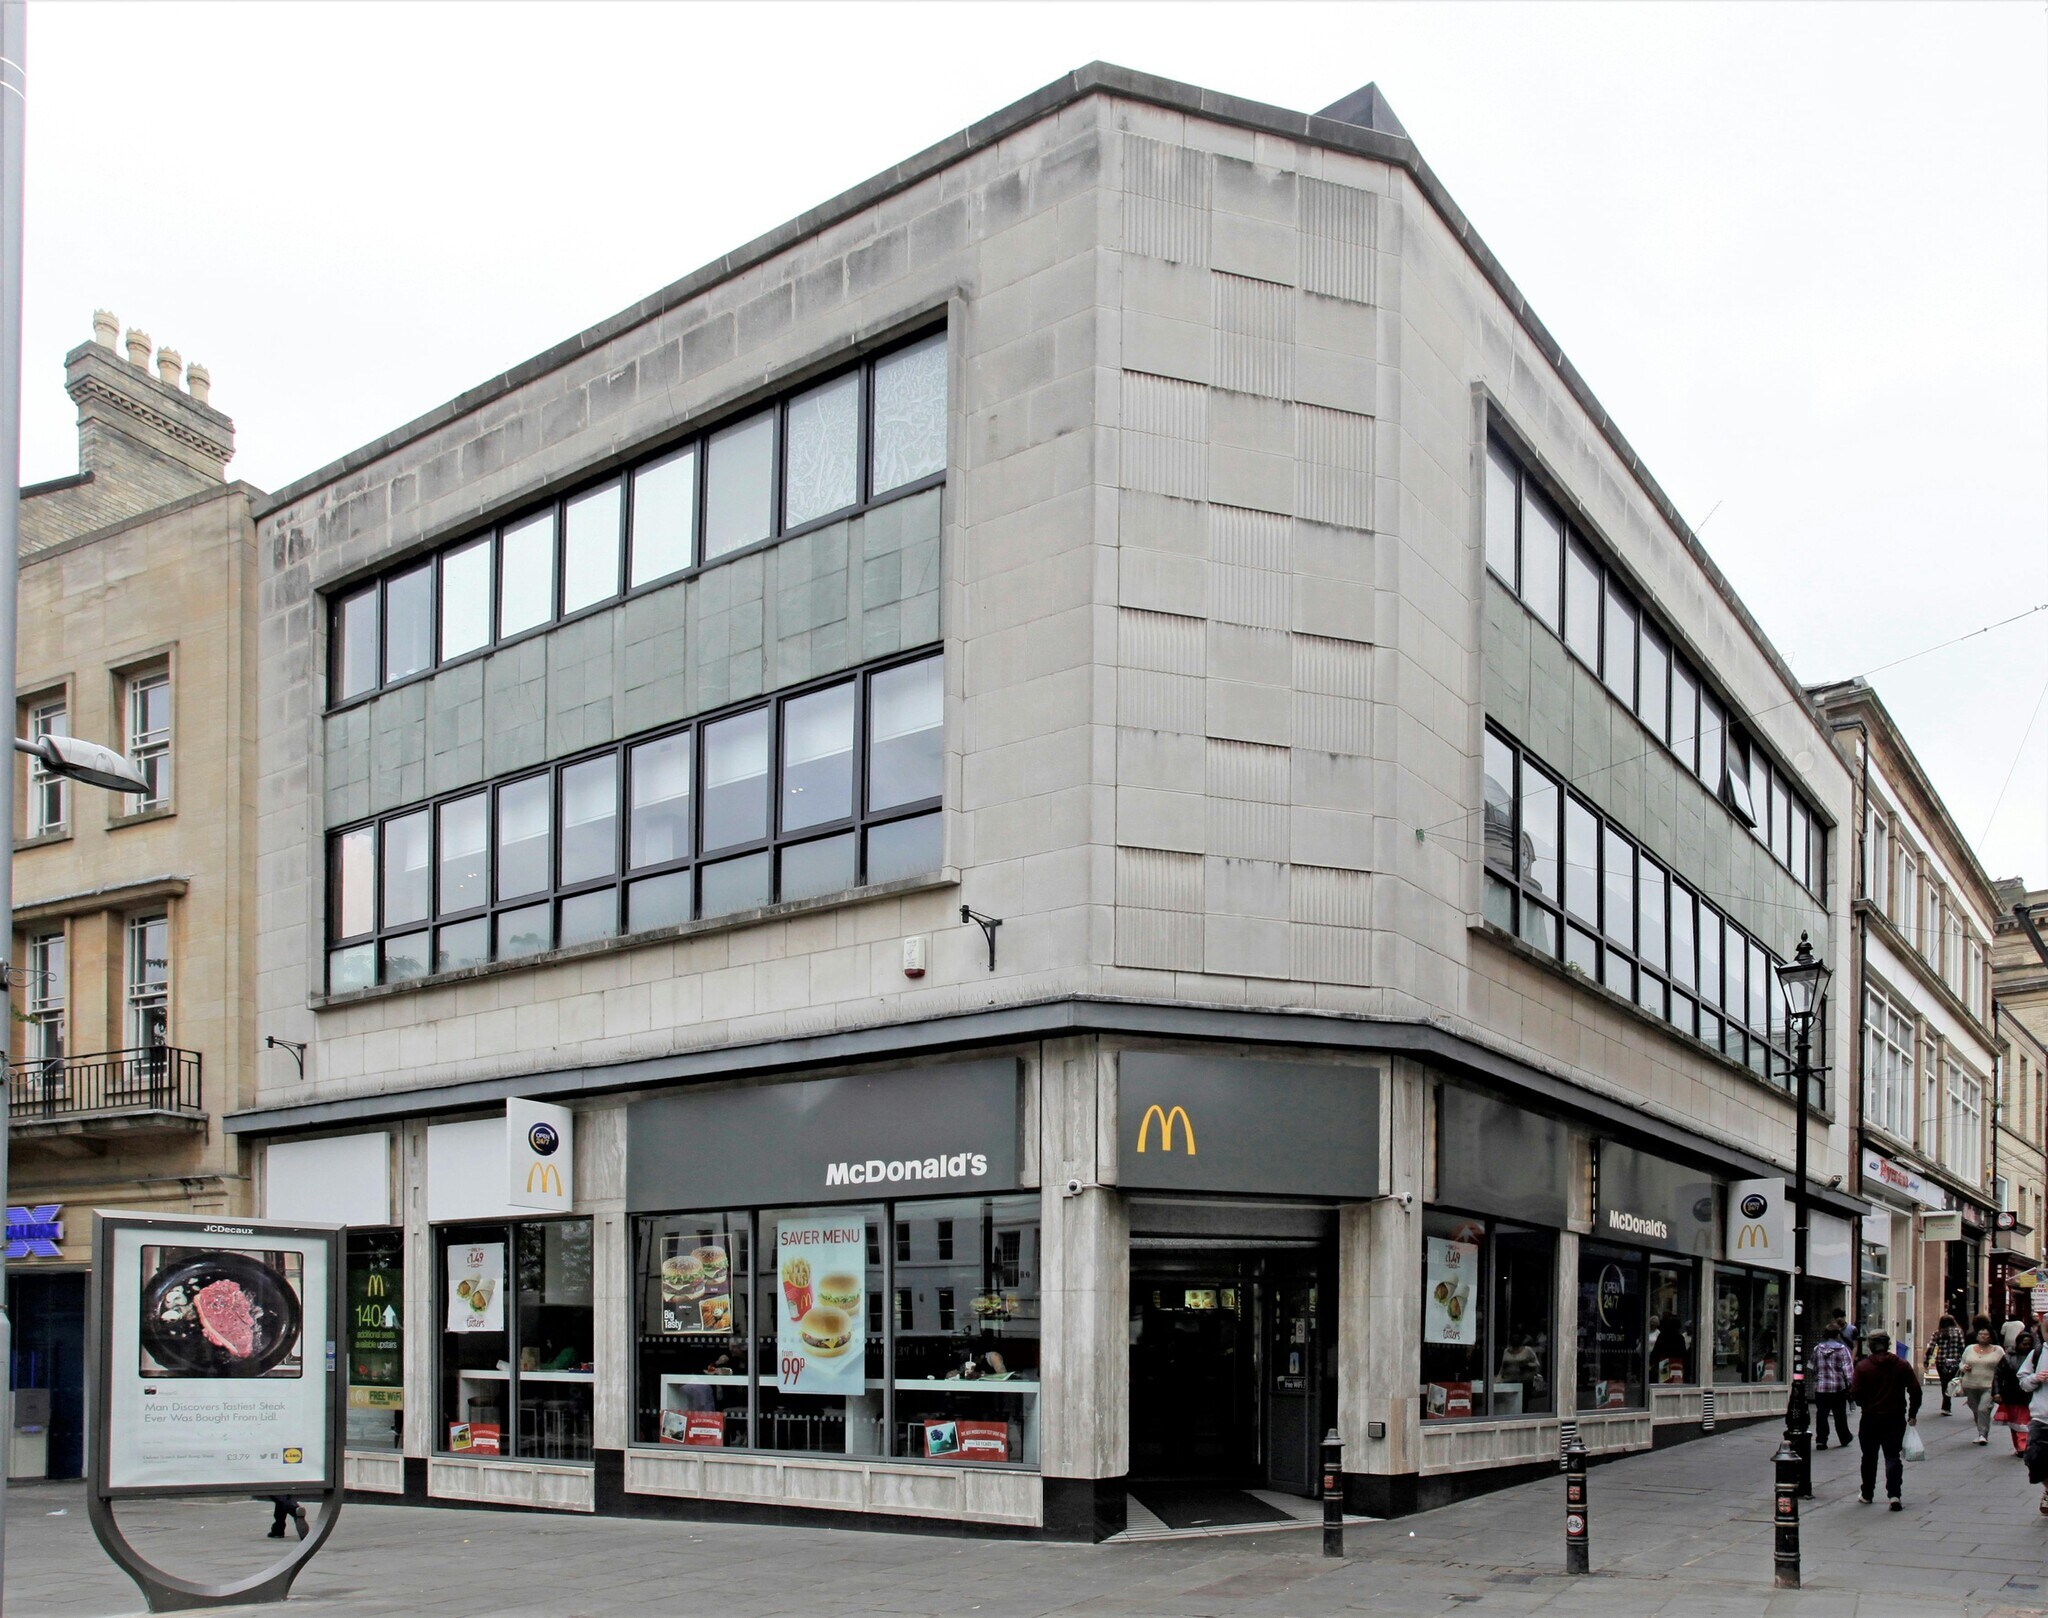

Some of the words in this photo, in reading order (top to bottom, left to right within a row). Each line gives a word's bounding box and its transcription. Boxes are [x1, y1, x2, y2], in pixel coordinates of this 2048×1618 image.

[825, 1152, 988, 1186] McDonald's
[203, 1224, 254, 1235] JCDecaux
[1609, 1209, 1668, 1239] McDonald's
[781, 1230, 820, 1246] SAVER
[823, 1229, 860, 1244] MENU
[1604, 1281, 1619, 1293] OPEN
[1604, 1294, 1619, 1309] 24/7
[356, 1304, 381, 1327] 140
[664, 1310, 675, 1321] Big
[664, 1320, 683, 1330] Tasty
[781, 1357, 805, 1385] 99p
[369, 1390, 386, 1401] FREE
[144, 1403, 168, 1412] Man
[172, 1402, 220, 1411] Discovers
[222, 1402, 256, 1411] Tastiest
[259, 1401, 286, 1410] Steak
[144, 1414, 167, 1423] Ever
[170, 1413, 193, 1422] Was
[196, 1412, 230, 1424] Bought
[233, 1413, 258, 1422] From
[227, 1453, 250, 1461] £3.79
